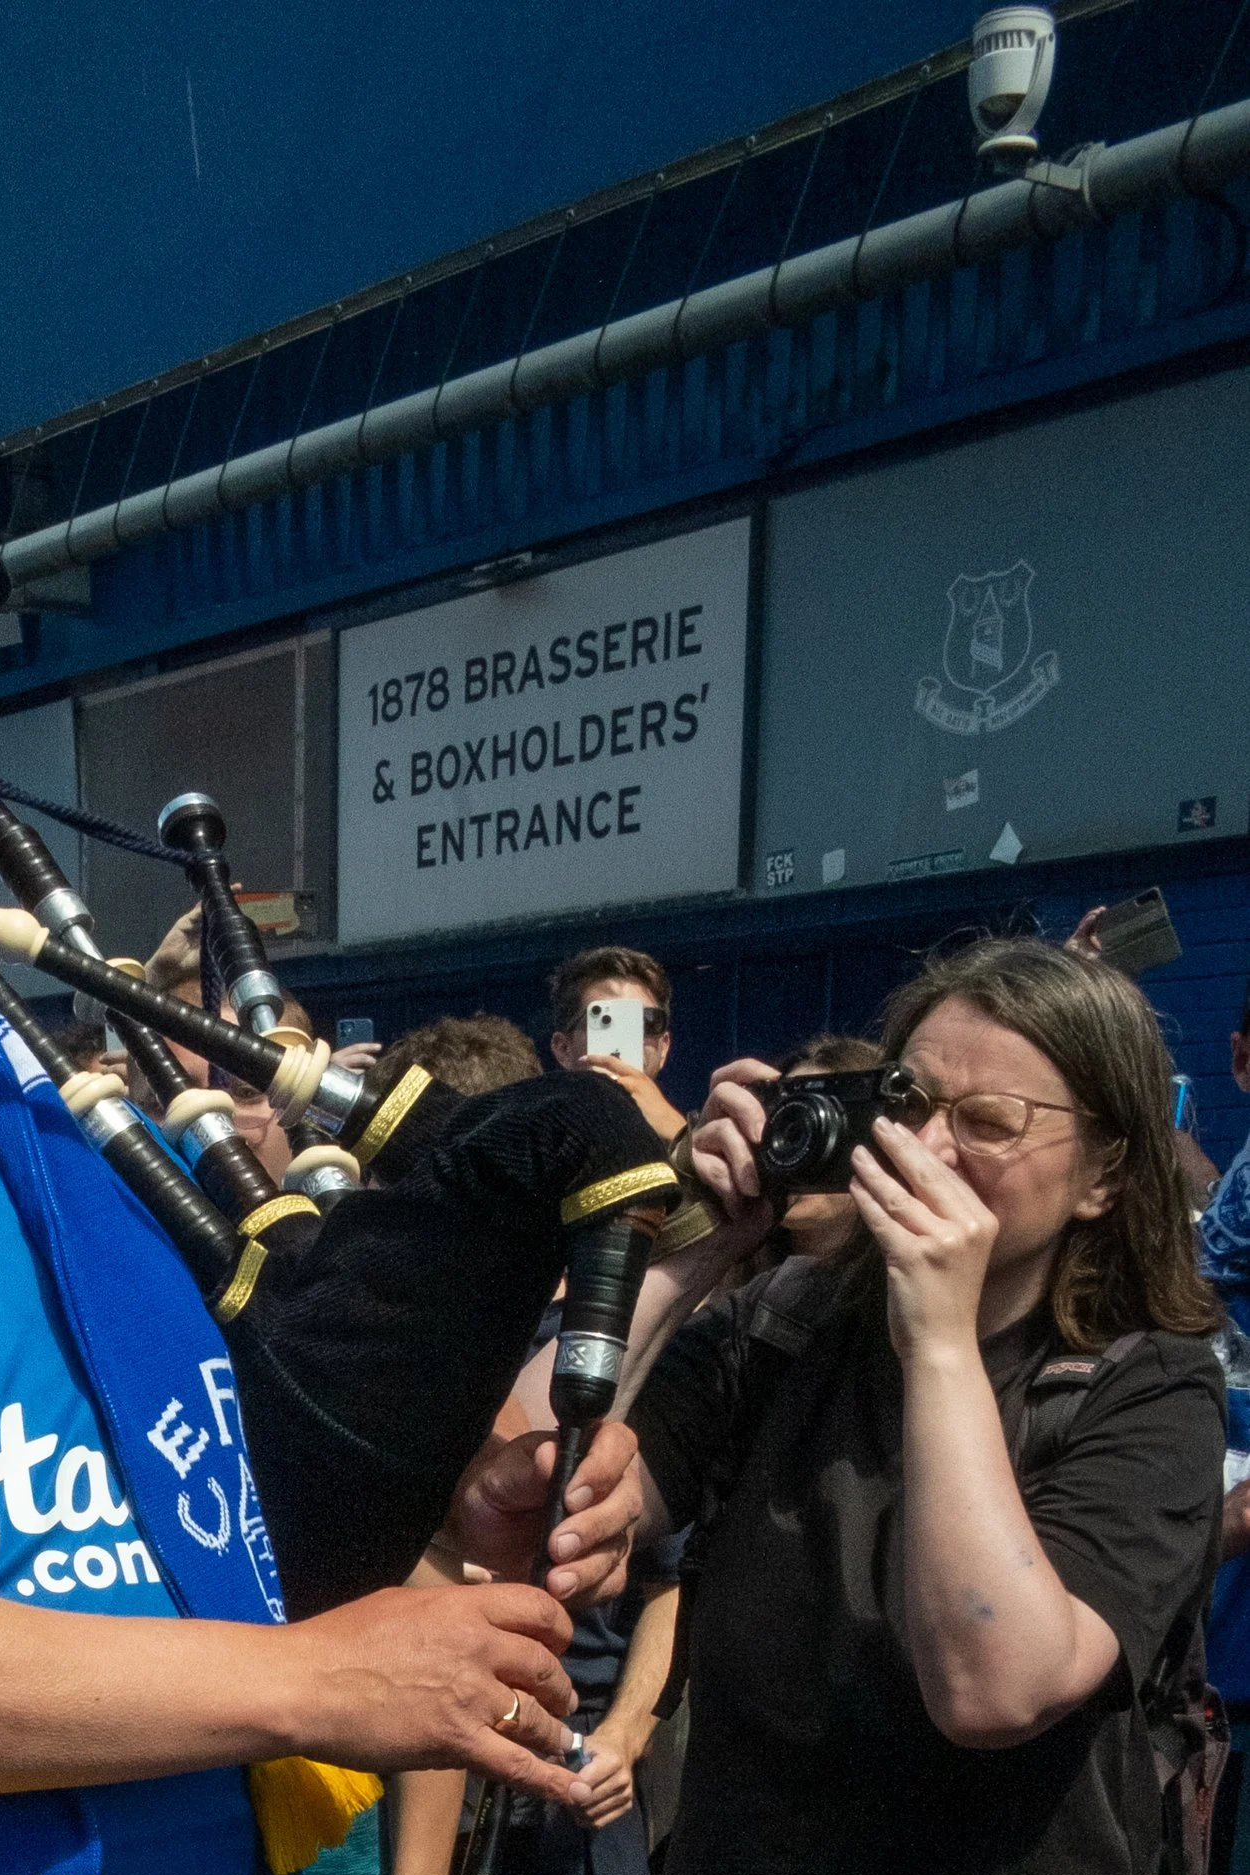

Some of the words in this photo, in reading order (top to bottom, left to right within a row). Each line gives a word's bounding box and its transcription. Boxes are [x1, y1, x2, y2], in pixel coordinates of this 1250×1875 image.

[367, 667, 449, 726] 1878
[464, 605, 703, 704] BRASSERIE
[372, 760, 395, 804] &
[411, 683, 709, 796] BOXHOLDERS'
[417, 786, 642, 869] ENTRANCE
[766, 853, 793, 871] FCK
[767, 868, 794, 886] STP
